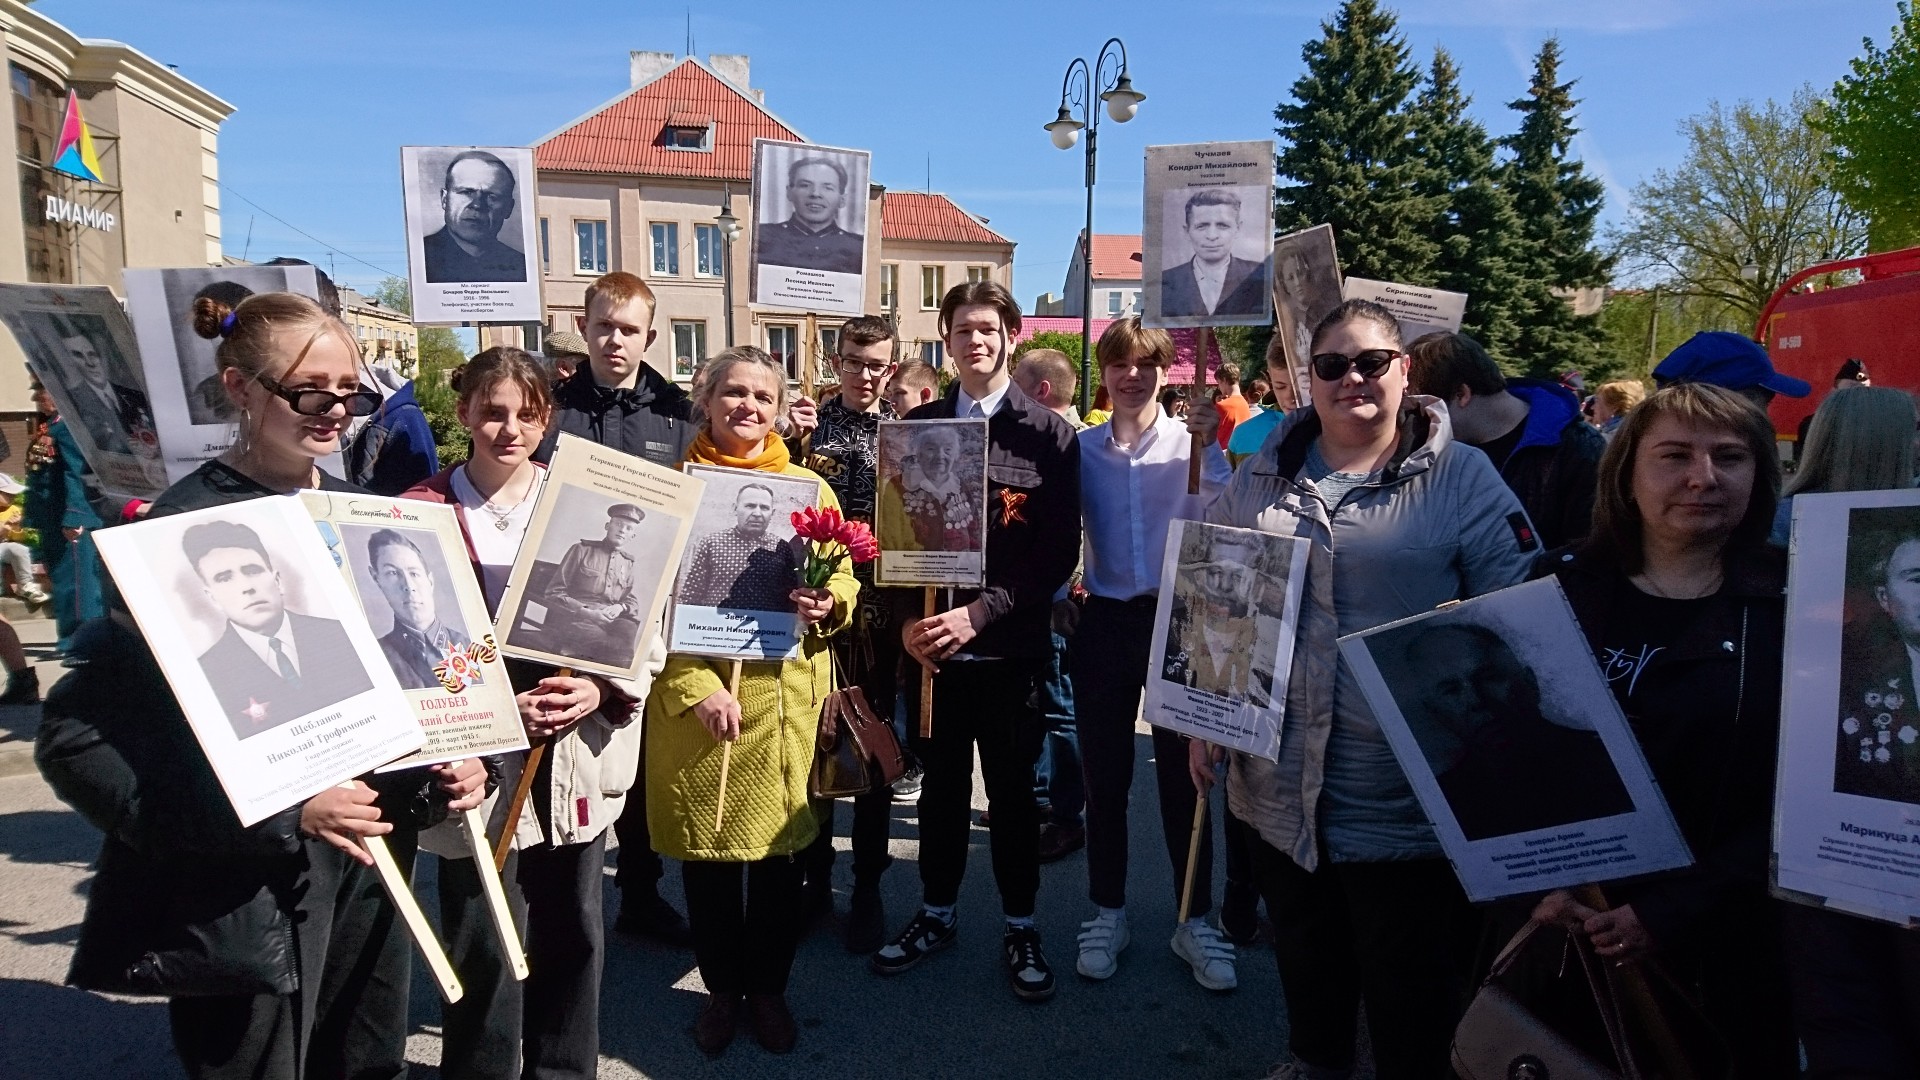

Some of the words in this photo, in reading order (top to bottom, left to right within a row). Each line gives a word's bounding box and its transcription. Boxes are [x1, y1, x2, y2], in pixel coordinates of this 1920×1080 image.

[45, 194, 114, 232] ДИАМИР
[1385, 287, 1432, 299] Скрипников
[1396, 299, 1437, 310] Ефимович
[623, 465, 646, 477] Георгий
[647, 474, 680, 488] Степанович
[725, 613, 755, 622] Зверев
[689, 623, 723, 631] Михаил
[726, 626, 785, 637] Никифорович
[420, 697, 468, 710] ГОЛУБЕВ
[445, 711, 494, 723] Семёнович
[1212, 710, 1224, 718] 2007
[290, 712, 342, 736] Щебланов
[267, 739, 314, 764] Николай
[317, 715, 376, 743] Трофимович
[1524, 837, 1556, 846] Генерал
[1557, 832, 1584, 841] Армии
[1841, 822, 1907, 842] Марикуца
[1539, 842, 1574, 854] Афанасий
[1538, 865, 1562, 875] Герой
[1563, 859, 1608, 870] Советского
[1608, 854, 1636, 863] Союза
